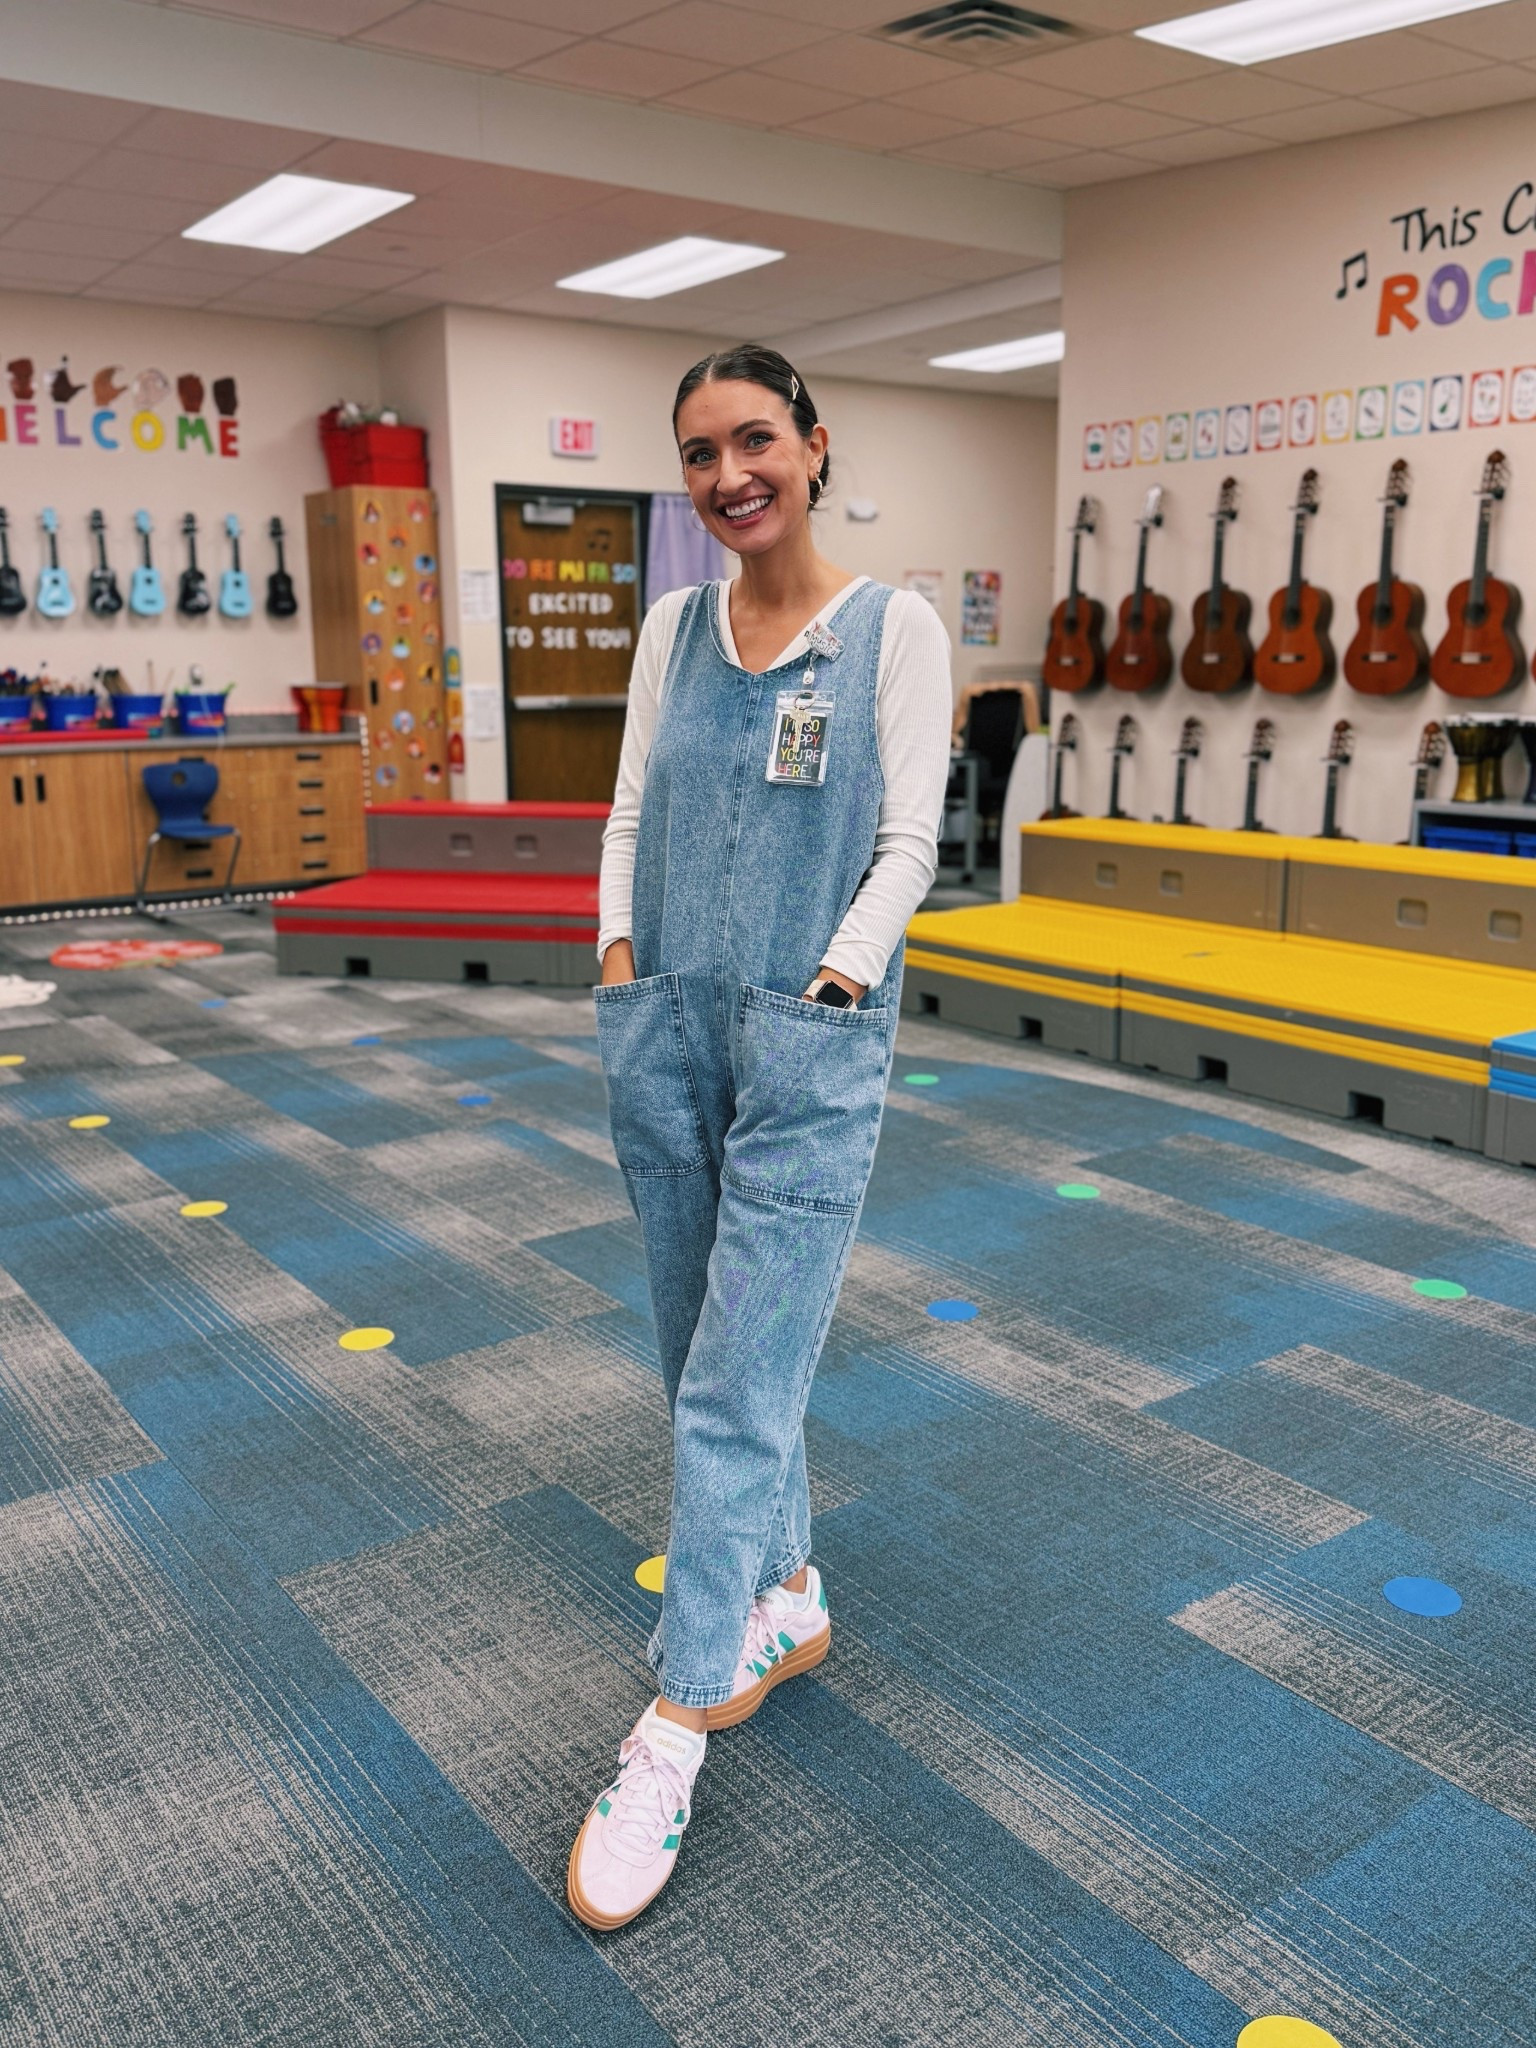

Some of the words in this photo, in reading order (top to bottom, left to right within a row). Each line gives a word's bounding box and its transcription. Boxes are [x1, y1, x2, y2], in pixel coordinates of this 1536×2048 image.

[1391, 206, 1482, 252] This
[0, 403, 239, 458] ELCOME
[561, 419, 593, 451] EXIT
[530, 559, 555, 581] RE
[559, 560, 585, 582] MI
[587, 562, 610, 583] FA
[612, 563, 636, 584] SO
[528, 592, 613, 615] EXCITED
[505, 626, 534, 649] TO
[541, 626, 578, 649] SEE
[584, 627, 631, 650] YOU!
[803, 719, 820, 733] SO
[782, 732, 820, 748] HAPPY
[780, 747, 820, 763] YOU'RE
[777, 762, 809, 778] HERE
[657, 1737, 686, 1755] adidas
